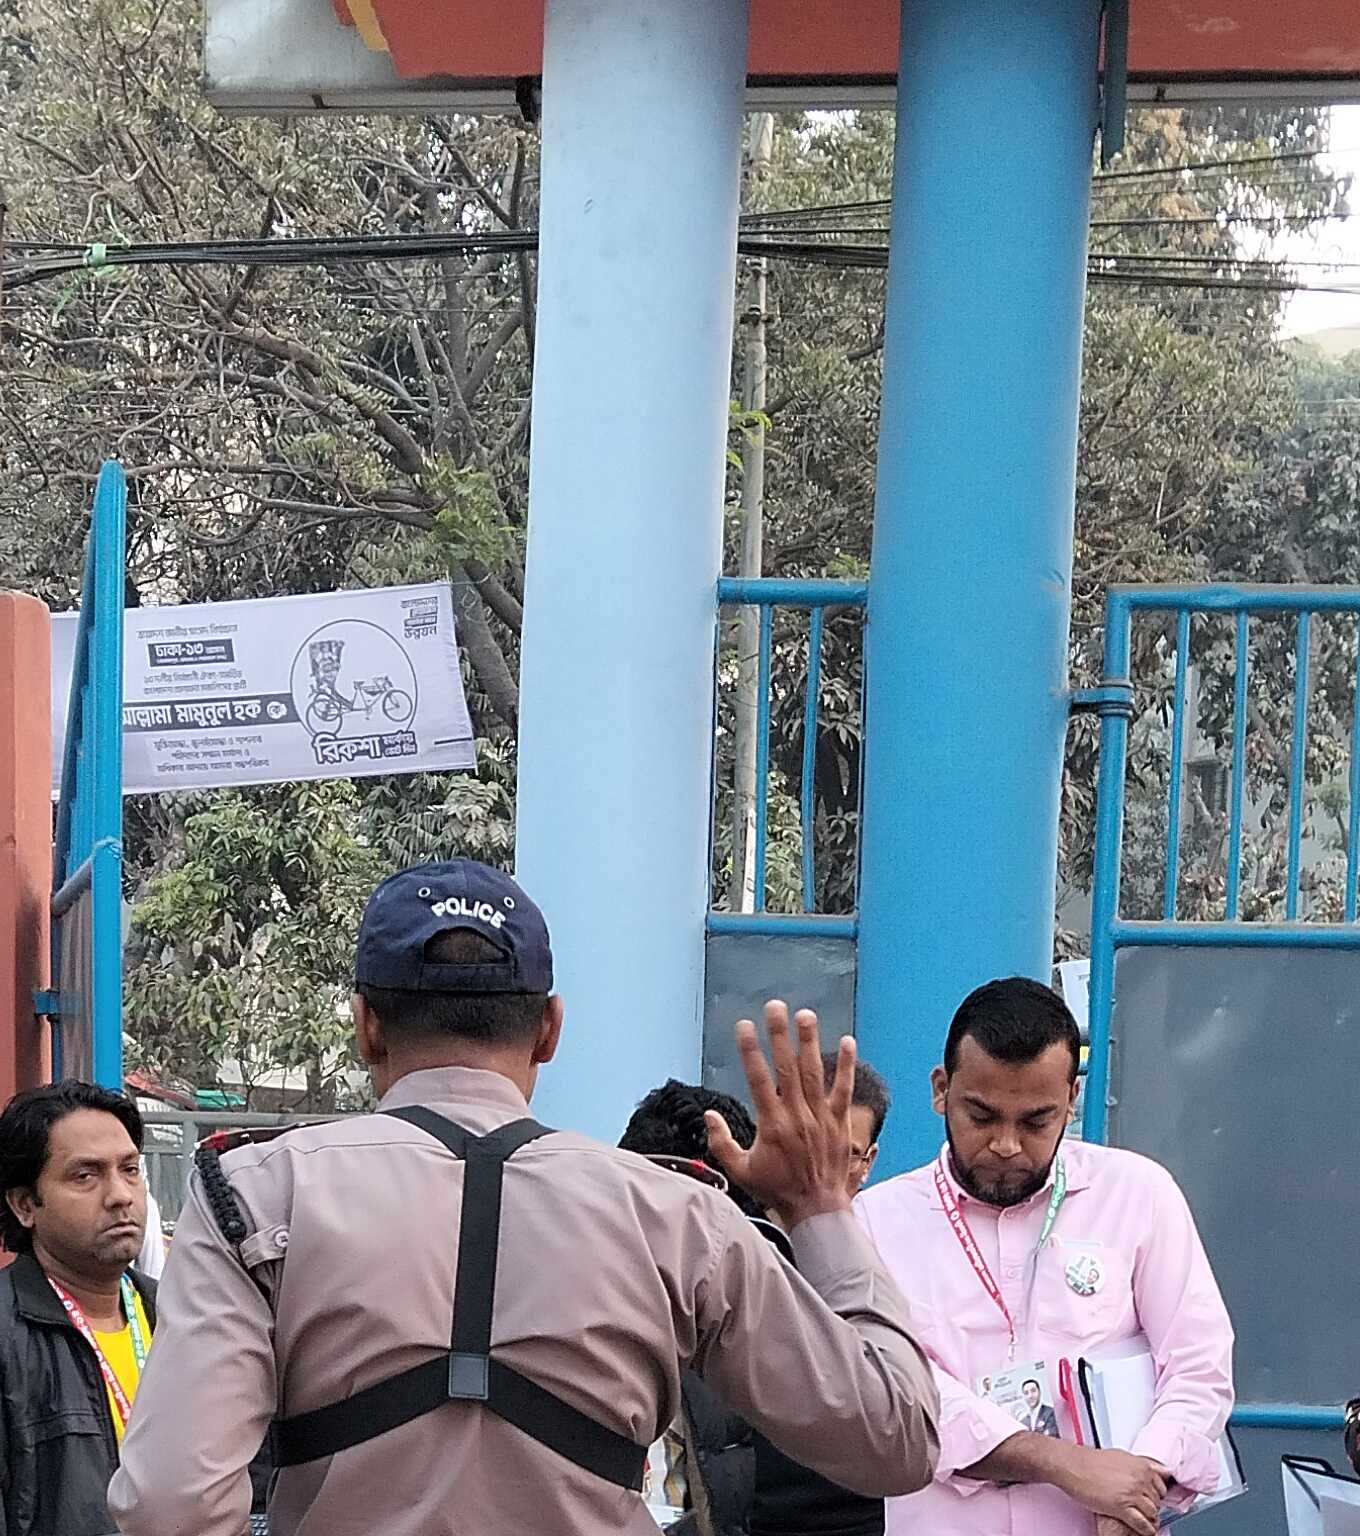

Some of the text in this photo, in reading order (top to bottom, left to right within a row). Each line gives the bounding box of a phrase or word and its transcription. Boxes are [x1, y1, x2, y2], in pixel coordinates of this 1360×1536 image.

[154, 643, 204, 657] ঢাকা-১৩
[174, 701, 232, 727] মামুনুল
[232, 699, 262, 721] হক
[313, 732, 382, 763] রিকশা
[431, 897, 506, 929] POLICE
